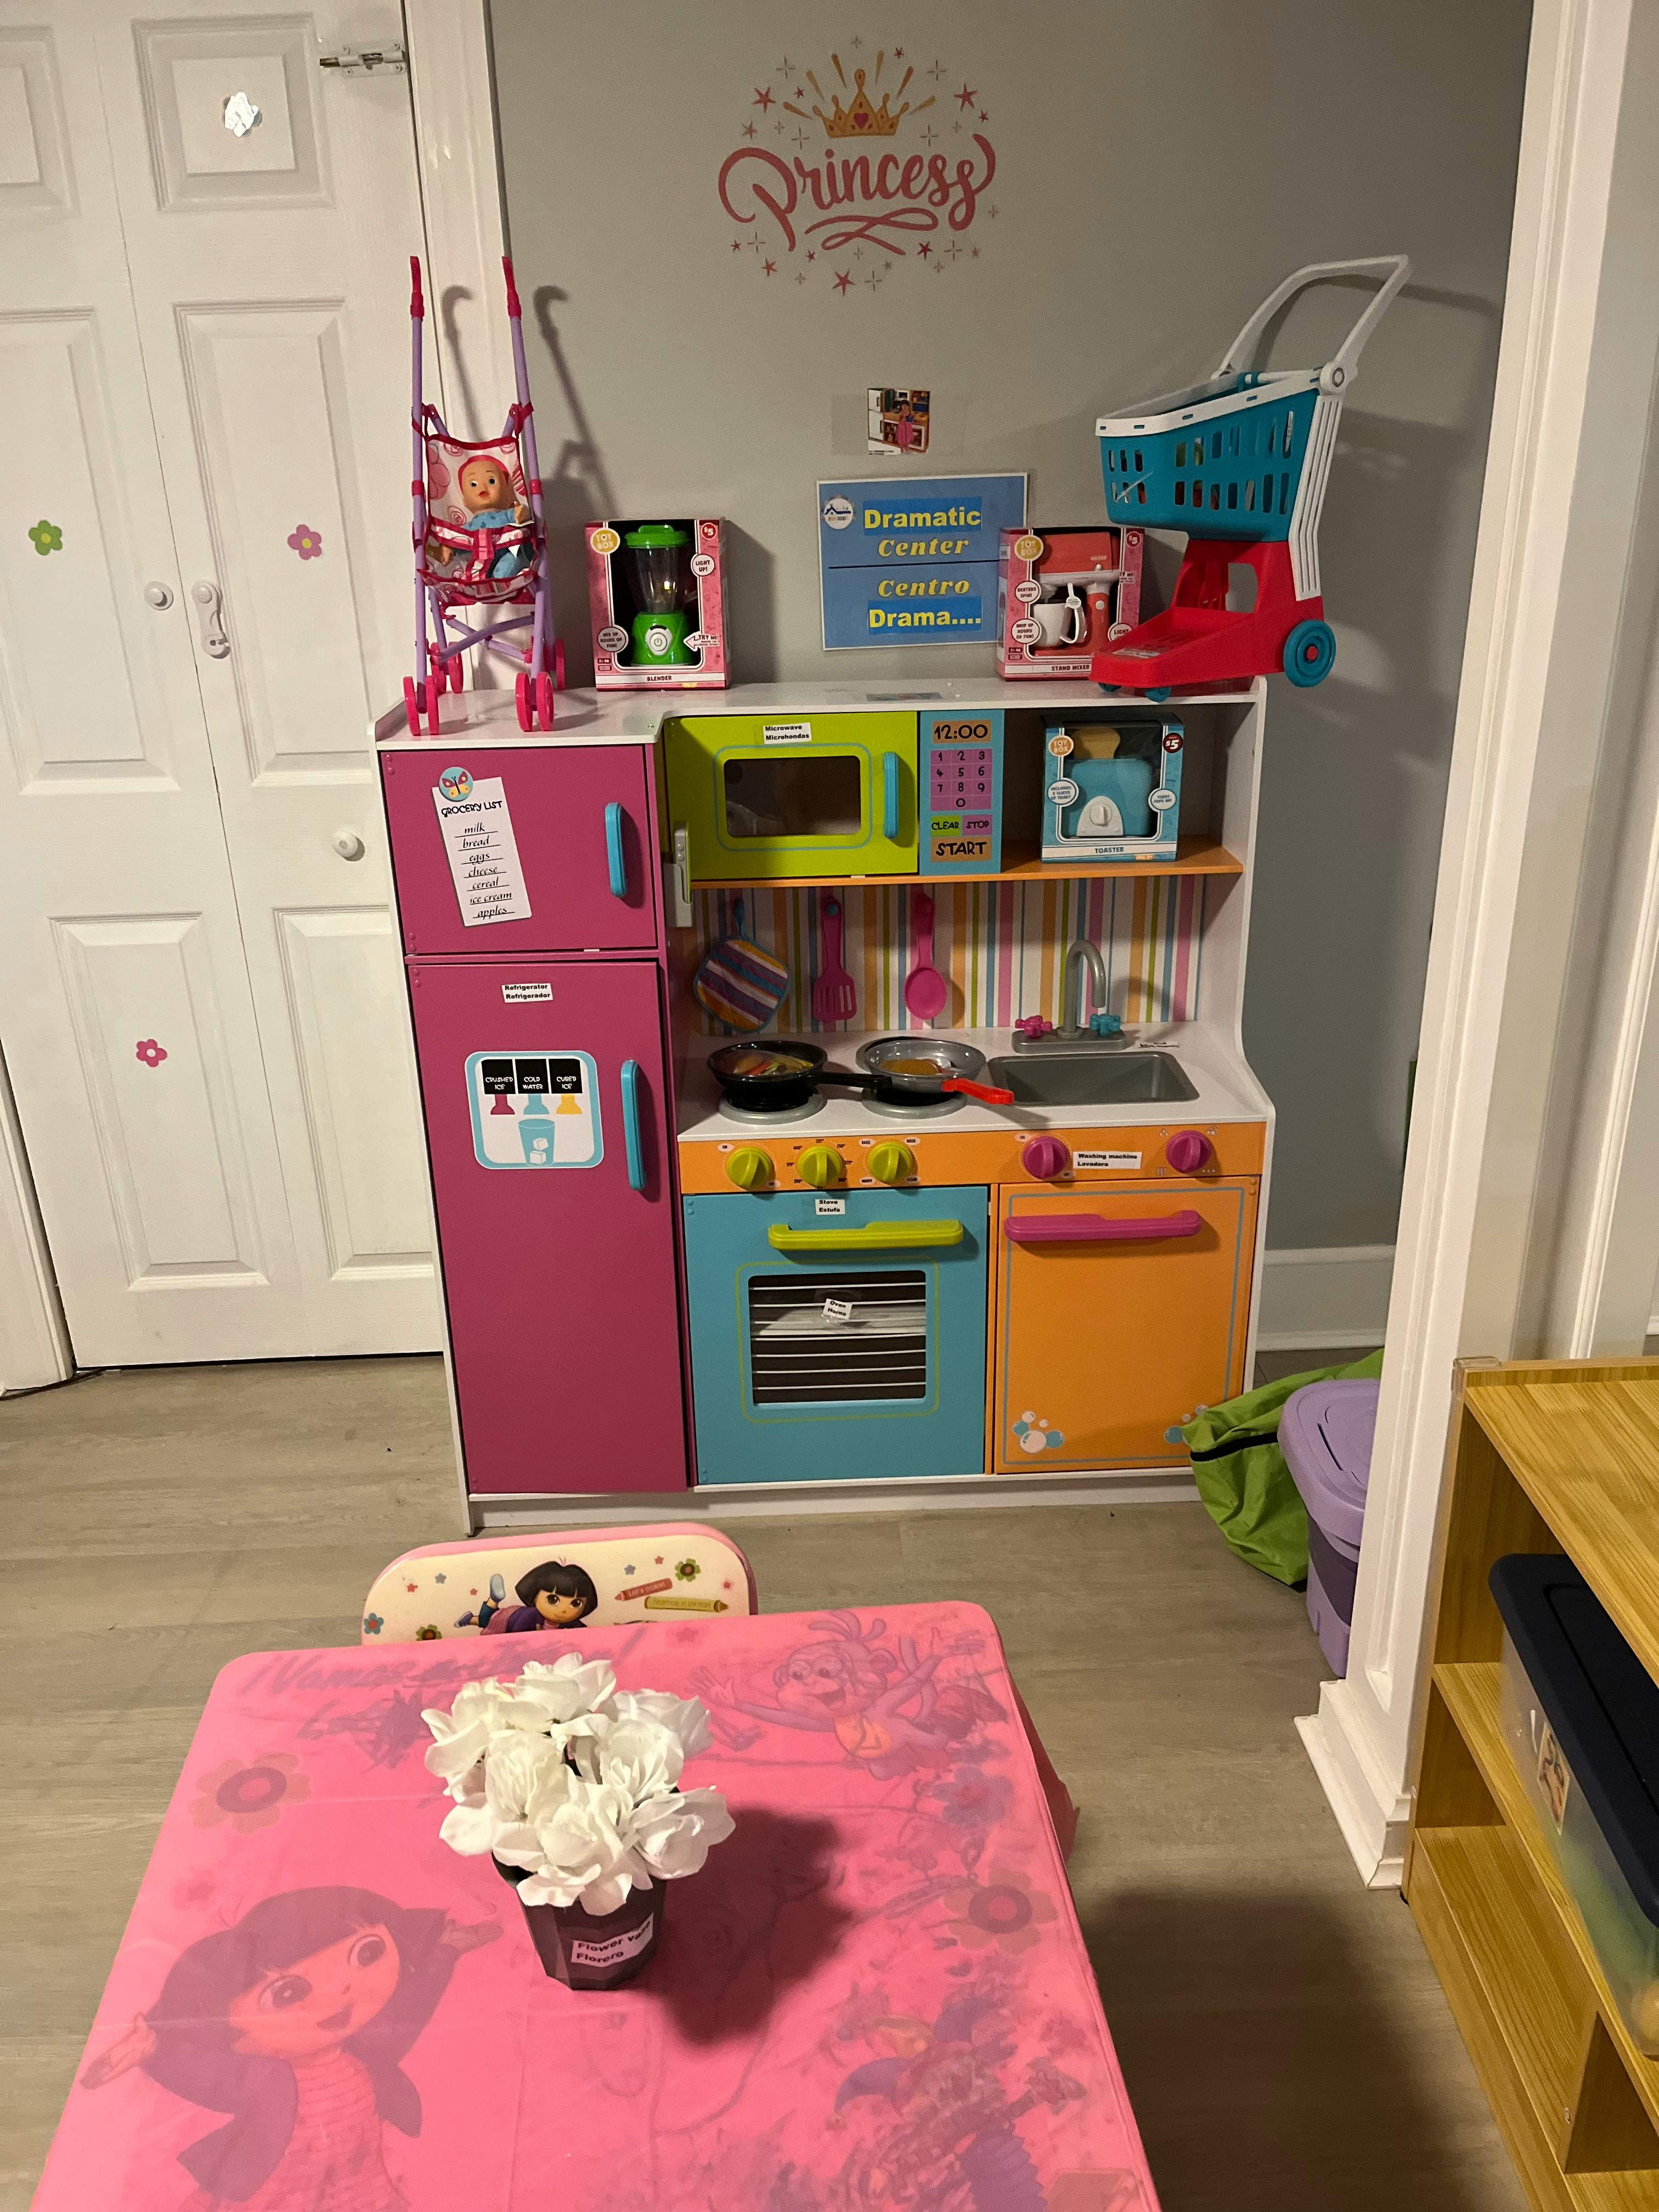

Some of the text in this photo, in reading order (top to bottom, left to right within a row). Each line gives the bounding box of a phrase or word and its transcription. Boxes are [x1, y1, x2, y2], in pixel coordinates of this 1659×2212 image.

[718, 133, 996, 252] Princess
[864, 506, 981, 529] Dramatic
[878, 539, 969, 557] Center
[878, 578, 970, 597] Centro
[934, 724, 988, 740] 12:00
[1165, 739, 1180, 750] $5
[938, 751, 985, 761] 1 2 3
[936, 766, 984, 777] 4 5 6
[937, 782, 985, 792] 7 8 9
[441, 800, 503, 817] GROCERY LIST
[465, 822, 485, 833] milk
[931, 821, 989, 831] CLEAR STOP
[462, 836, 489, 848] bread
[936, 841, 987, 856] START
[469, 853, 490, 865] eggs
[469, 866, 498, 878] cheese
[472, 877, 499, 889] cereal
[470, 892, 512, 904] ice cream
[477, 905, 507, 919] apples
[578, 1938, 623, 1952] Flower
[577, 1951, 624, 1963] Florero
